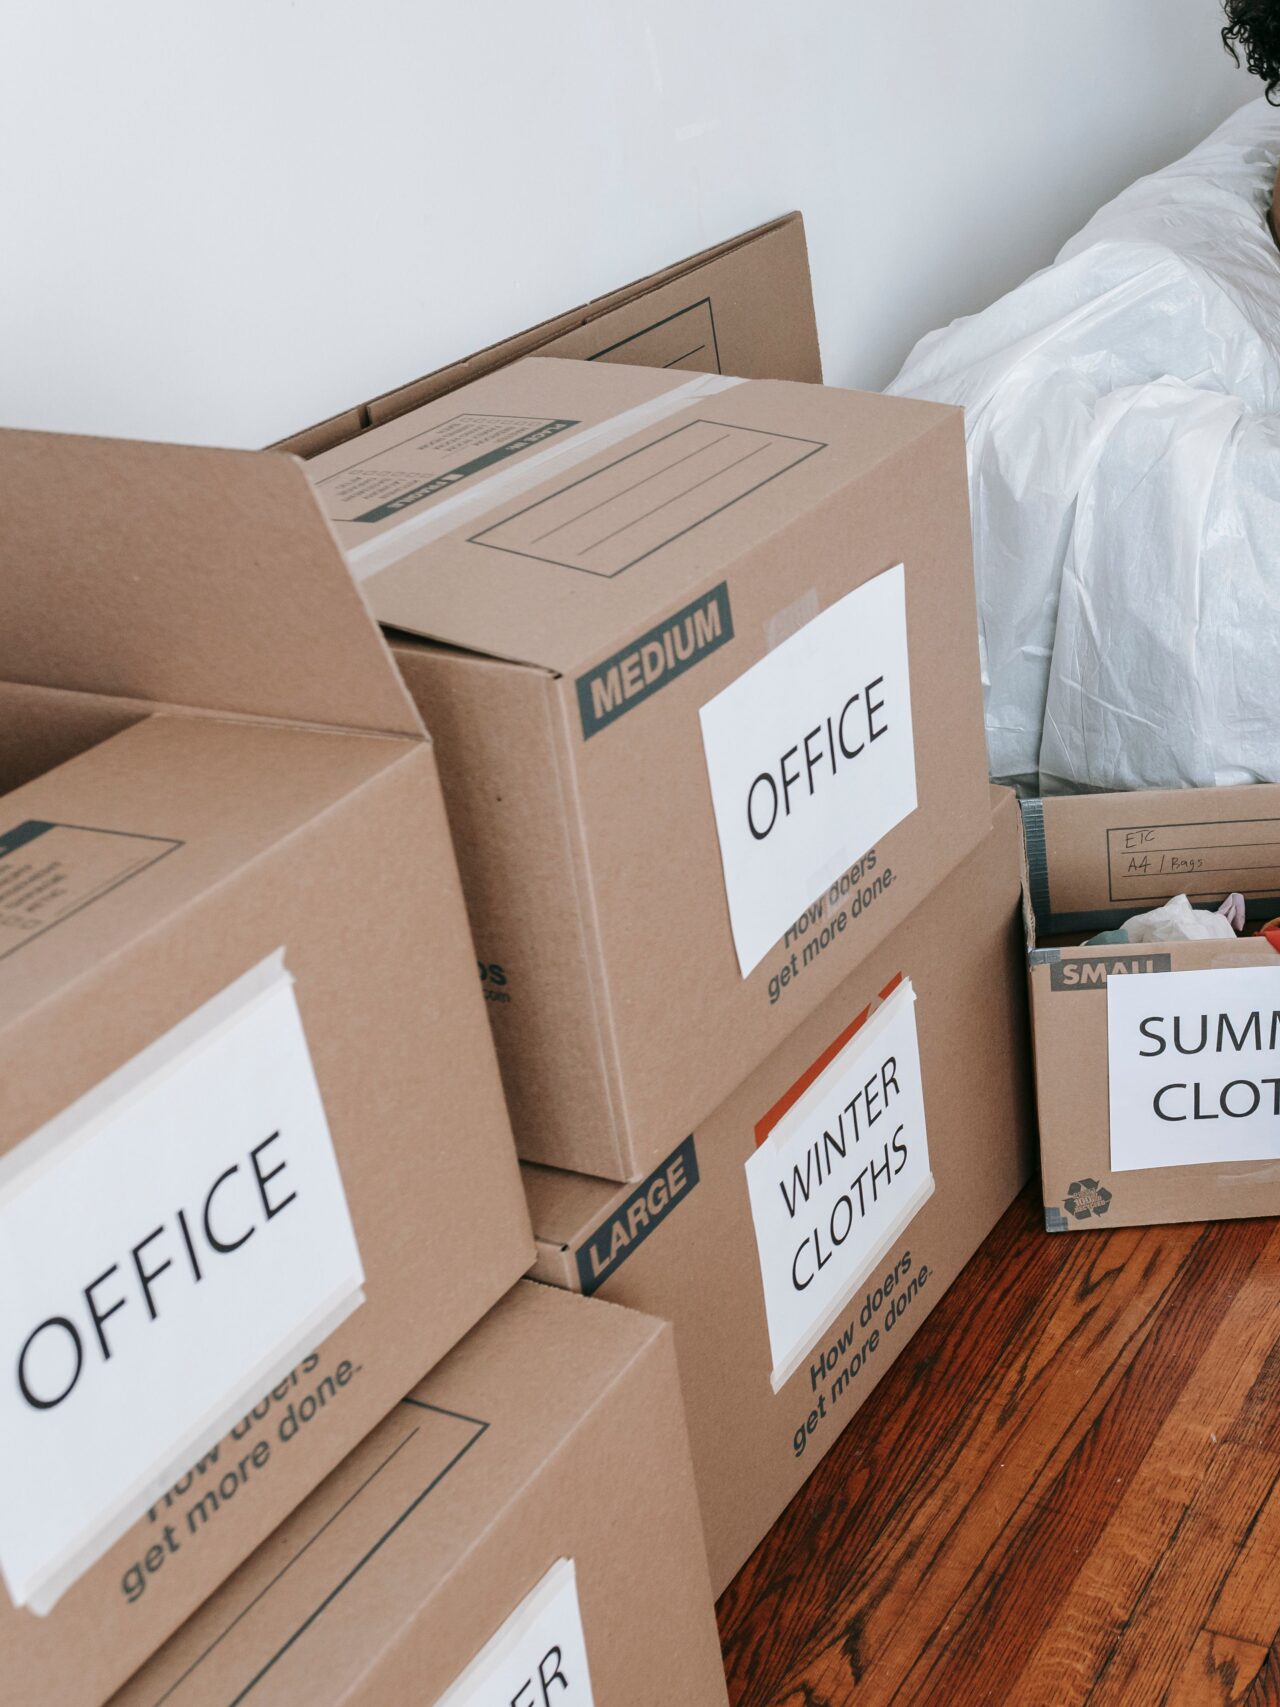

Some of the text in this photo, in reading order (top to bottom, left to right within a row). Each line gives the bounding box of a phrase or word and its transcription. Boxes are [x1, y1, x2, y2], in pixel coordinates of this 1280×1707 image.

[589, 599, 723, 720] MEDIUM
[747, 675, 889, 841] OFFICE
[1125, 829, 1156, 849] ETC
[767, 867, 898, 1005] get more done.
[589, 1154, 688, 1279] LARGE
[779, 1056, 901, 1219] WINTER
[792, 1124, 908, 1292] CLOTHS
[17, 1129, 298, 1411] OFFICE
[810, 1250, 912, 1393] How doers
[793, 1264, 934, 1458] get more done.
[121, 1359, 363, 1605] get more done.
